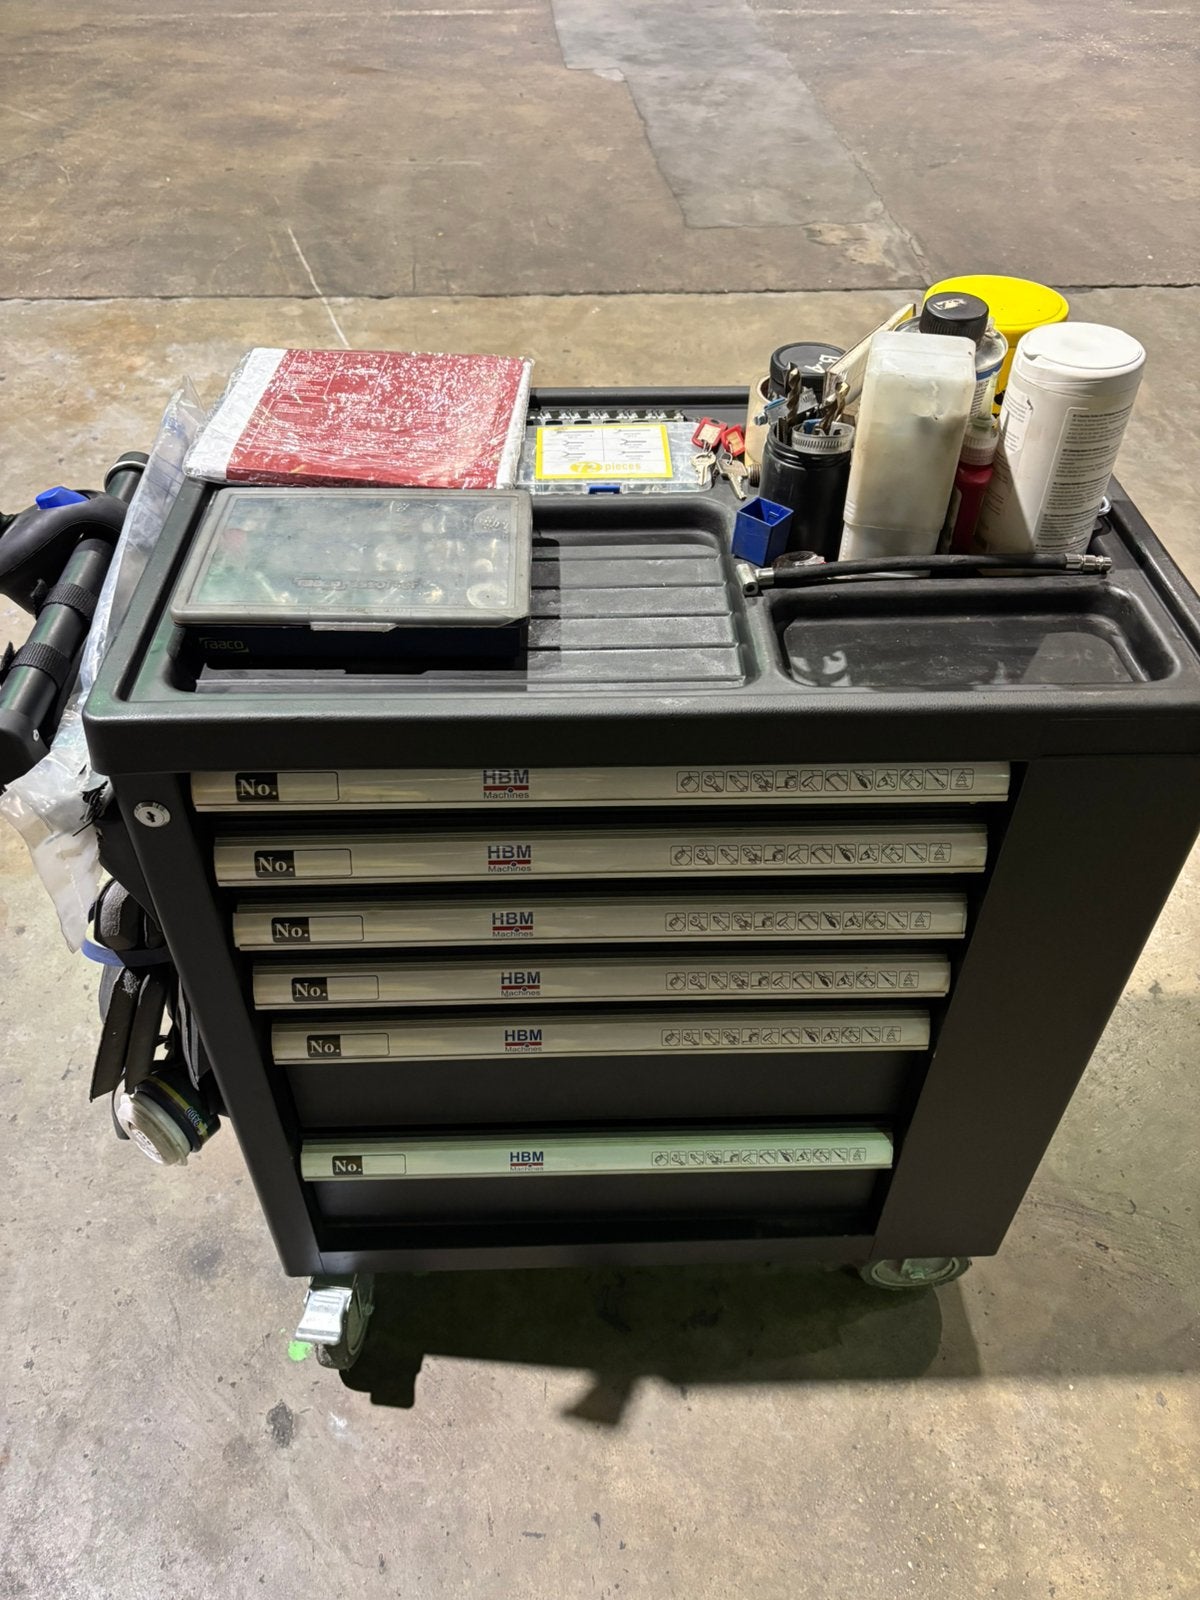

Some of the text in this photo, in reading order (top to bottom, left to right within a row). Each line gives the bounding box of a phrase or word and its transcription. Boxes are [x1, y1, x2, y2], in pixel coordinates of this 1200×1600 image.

[604, 463, 641, 472] pieces
[204, 640, 245, 650] raaco
[483, 769, 529, 785] HBM
[239, 779, 278, 797] No.
[483, 790, 530, 799] Machines
[487, 844, 532, 859] HBM
[257, 856, 294, 873] No.
[487, 865, 532, 873] Machines
[491, 911, 534, 925] HBM
[274, 922, 309, 938] No.
[491, 930, 534, 938] Machines
[500, 971, 541, 984] HBM
[295, 982, 327, 998] No.
[504, 1029, 542, 1041] HBM
[309, 1039, 341, 1054] No.
[509, 1151, 544, 1162] HBM
[334, 1159, 362, 1173] No.
